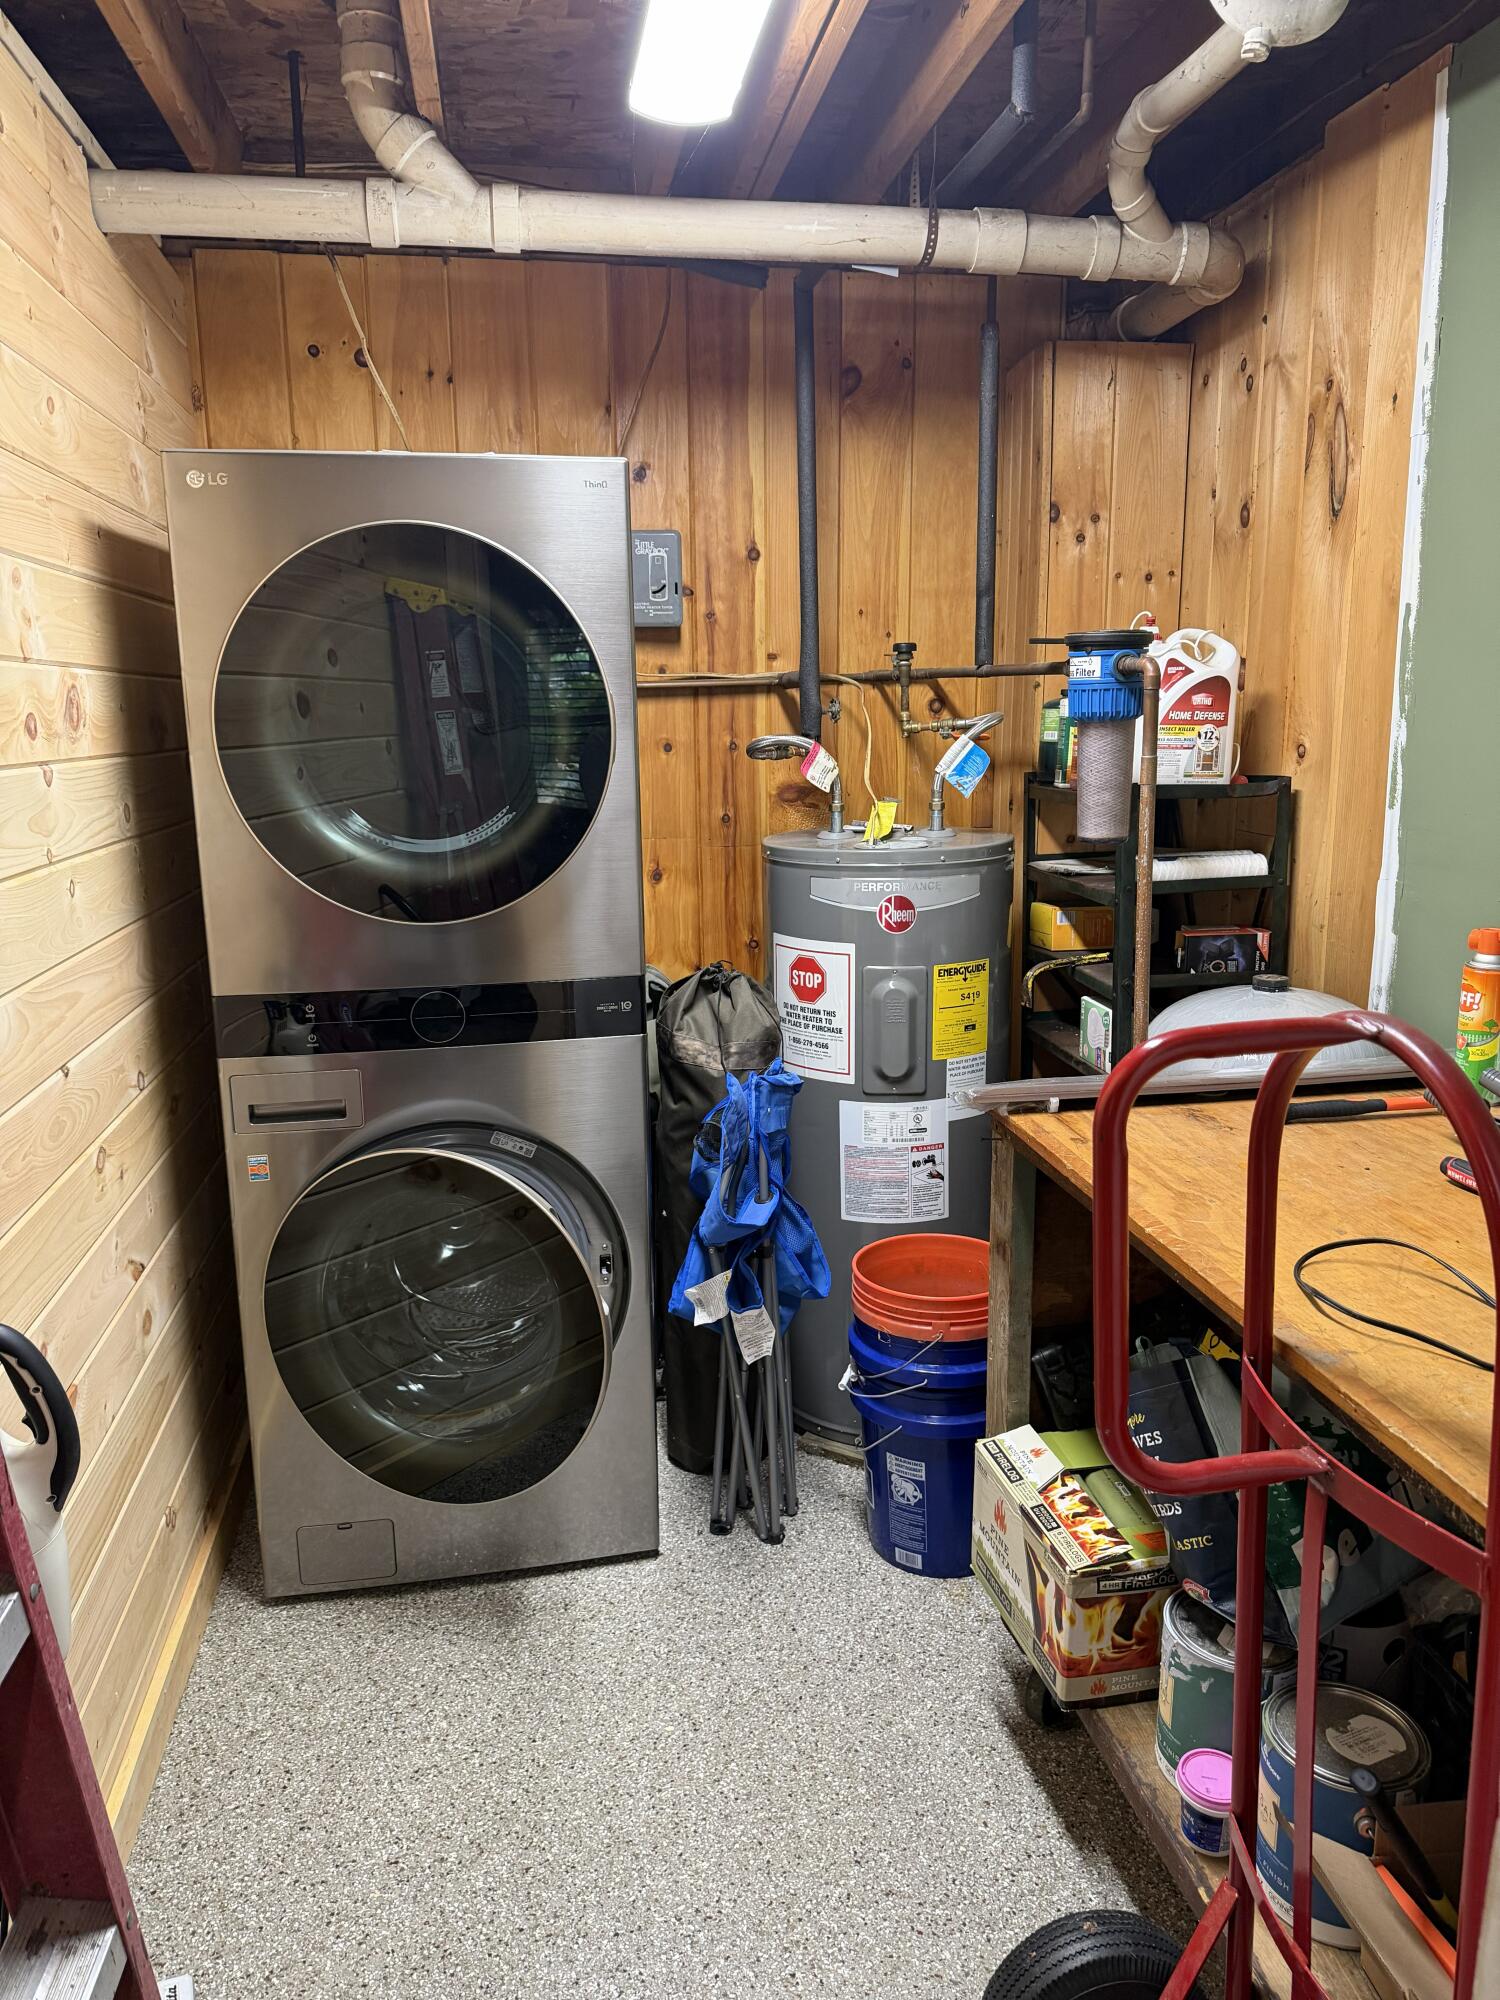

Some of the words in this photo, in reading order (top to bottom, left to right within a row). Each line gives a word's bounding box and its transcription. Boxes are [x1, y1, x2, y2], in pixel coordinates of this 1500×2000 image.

[207, 472, 229, 486] LG
[584, 480, 608, 489] ThinQ
[1076, 668, 1096, 677] Filter
[1168, 711, 1192, 720] HOME
[1194, 711, 1226, 721] DEFENSE
[1203, 731, 1215, 740] 12
[854, 881, 943, 893] PERFORMANCE
[881, 895, 915, 928] Rheem
[937, 962, 987, 978] ENERGYGUIDE
[792, 970, 822, 988] STOP
[1460, 993, 1481, 1010] FF!
[786, 1011, 801, 1020] WATER
[802, 1015, 823, 1025] HEATER
[824, 1018, 833, 1026] TO
[800, 1006, 821, 1016] RETURN
[823, 1009, 837, 1018] THIS
[787, 1018, 802, 1029] PLACE
[803, 1022, 811, 1030] OF
[812, 1025, 843, 1034] PURCHASE
[918, 1143, 943, 1151] DANGER
[1447, 1169, 1477, 1188] RAFTSMAN
[895, 1457, 923, 1468] WARNING
[994, 1453, 1019, 1482] FIRELOG
[990, 1523, 1010, 1557] PINE
[978, 1520, 1021, 1588] MOUNTAIN
[1060, 1536, 1084, 1563] FIRELOGS
[1124, 1575, 1177, 1590] FIRELOG
[1111, 1679, 1157, 1691] MOUNTA
[1112, 1674, 1138, 1684] PINE
